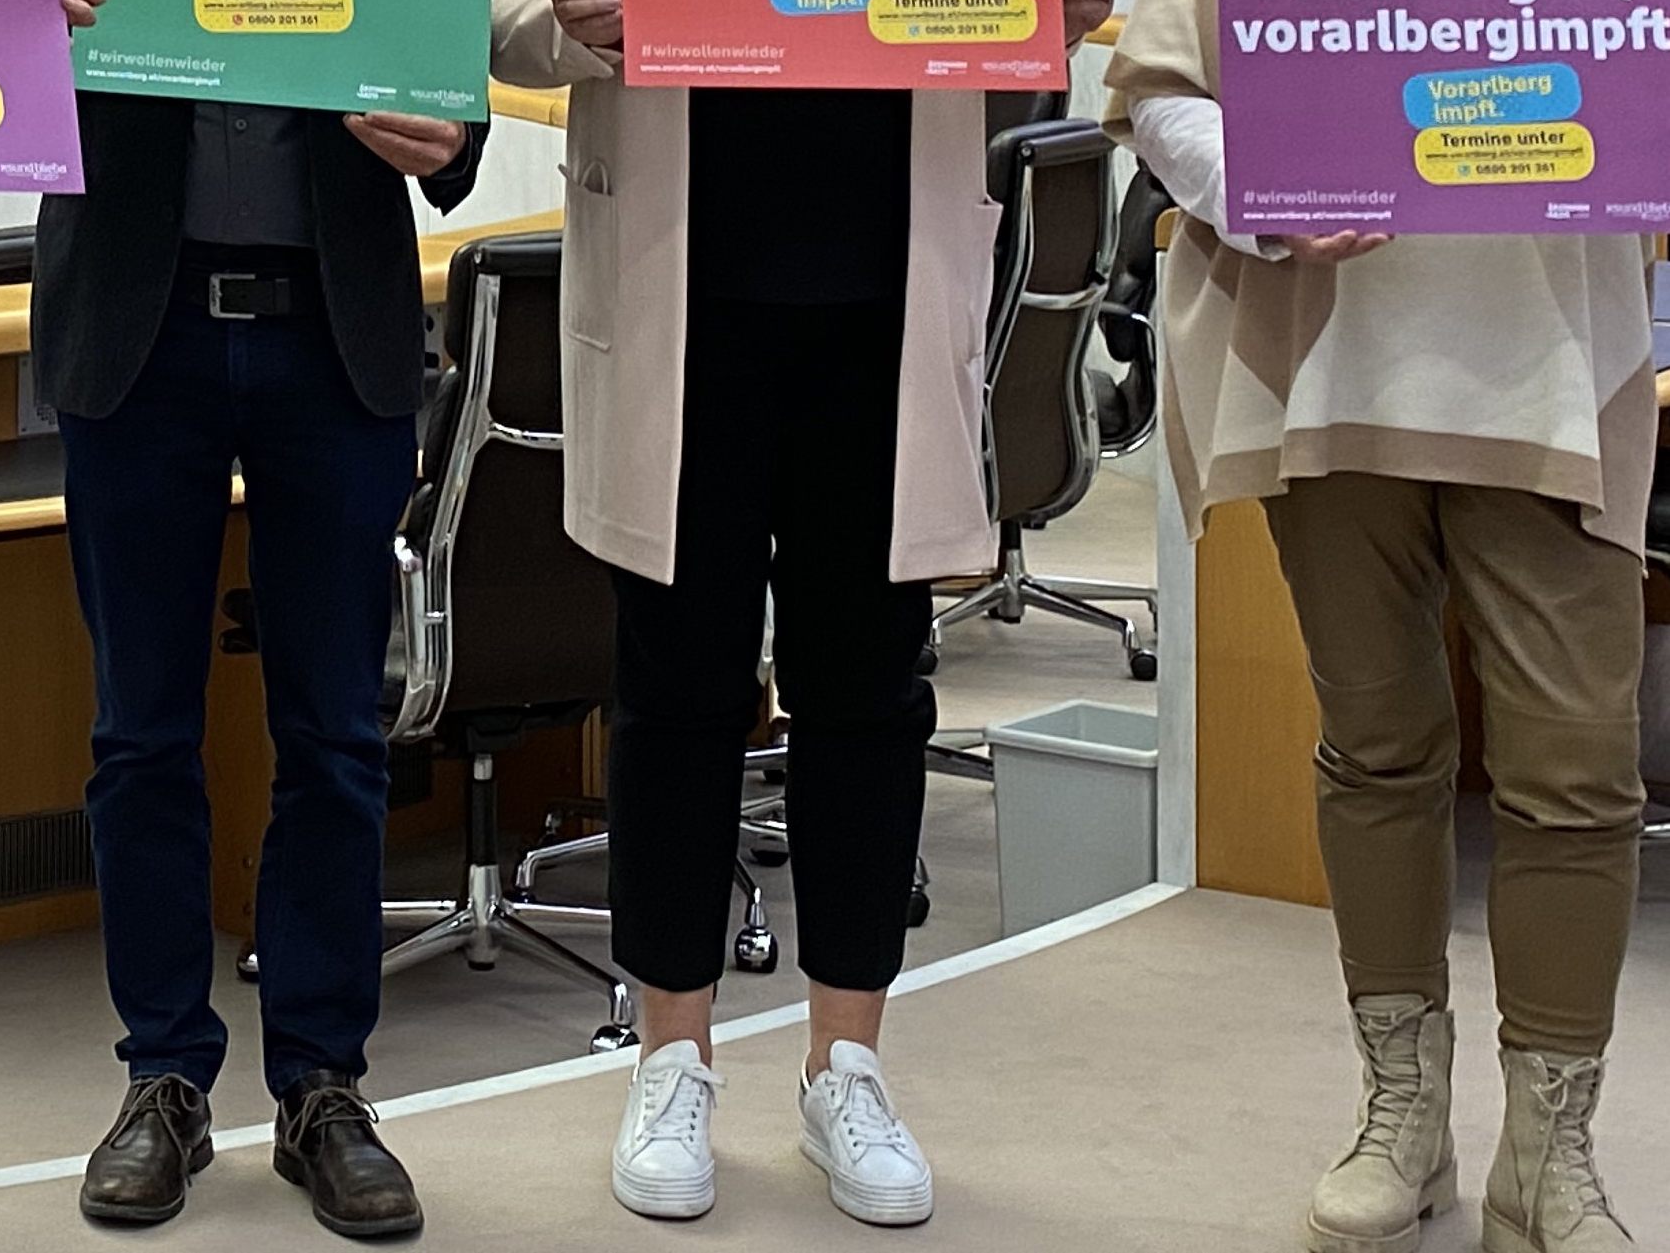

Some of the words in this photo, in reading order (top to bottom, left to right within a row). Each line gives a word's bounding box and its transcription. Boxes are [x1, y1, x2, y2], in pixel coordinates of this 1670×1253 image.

[1232, 6, 1670, 61] vorarlbergimpft
[88, 49, 226, 73] #wirwollenwieder
[641, 44, 785, 59] #wirwollenwieder
[1428, 74, 1553, 101] Vorarlberg
[1440, 132, 1512, 147] Termine
[1516, 130, 1566, 146] unter
[1243, 190, 1398, 205] #wirwollenwieder
